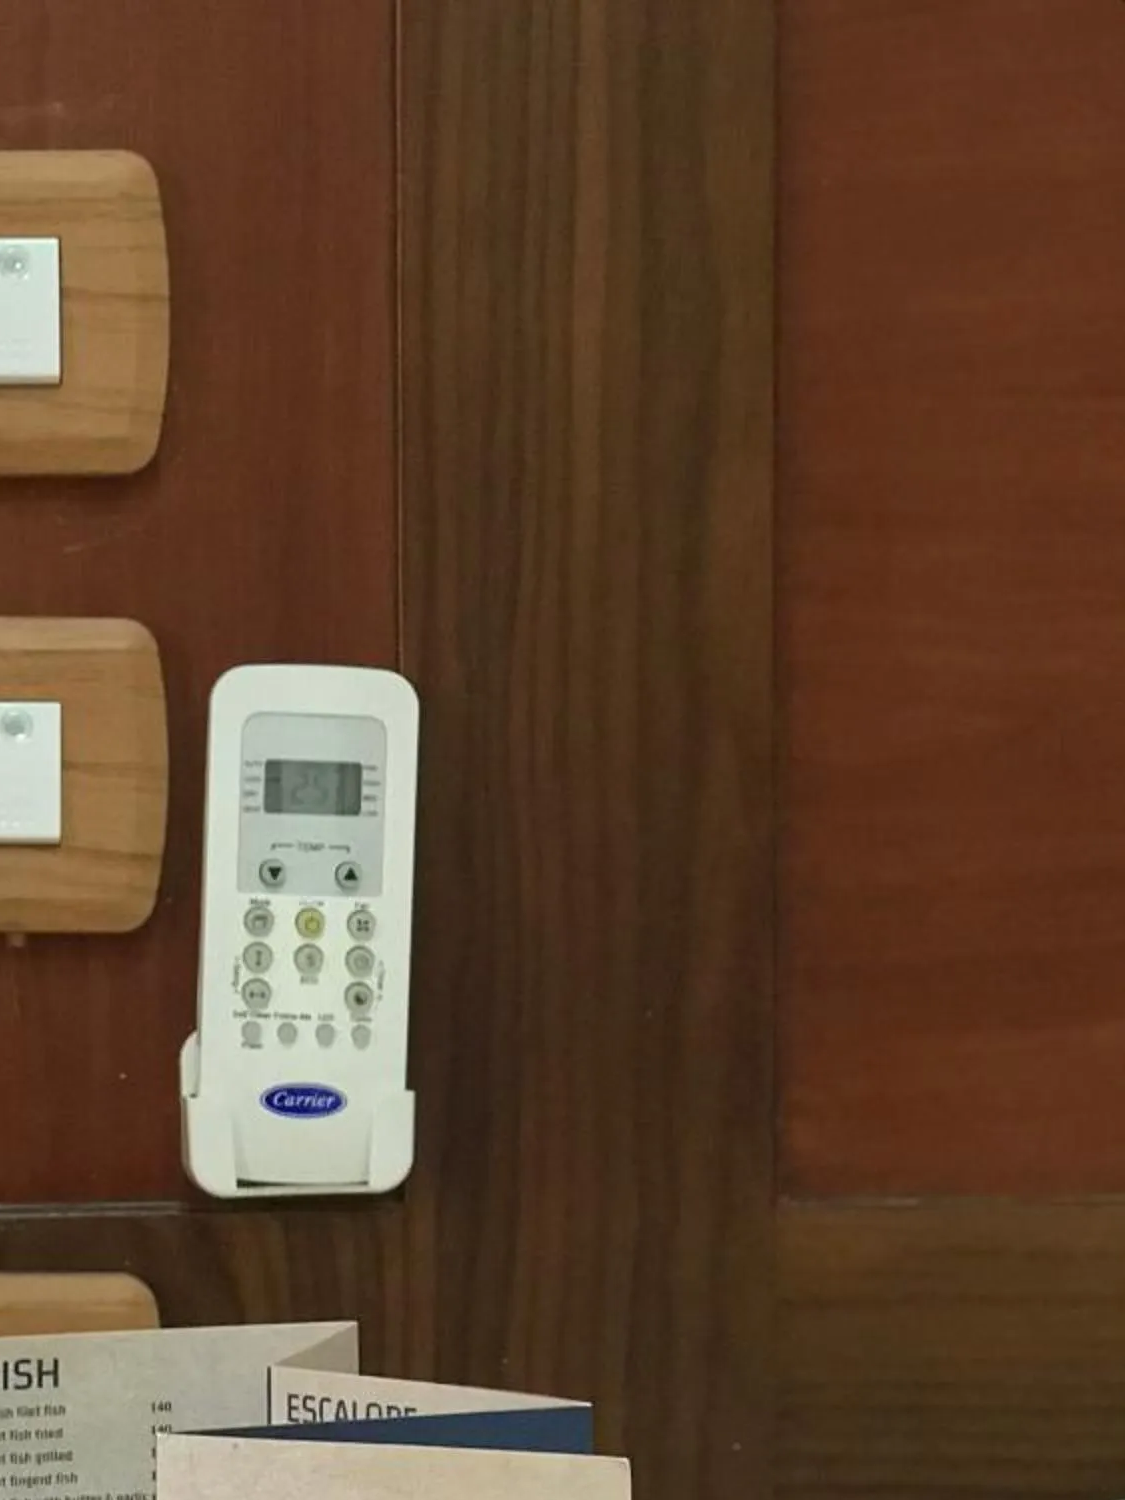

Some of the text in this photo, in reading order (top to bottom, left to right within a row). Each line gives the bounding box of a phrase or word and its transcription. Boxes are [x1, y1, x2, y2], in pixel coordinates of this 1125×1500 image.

[273, 1091, 335, 1108] Carrier
[44, 1404, 66, 1416] fish
[152, 1401, 172, 1413] 140
[10, 1429, 32, 1441] fish
[10, 1452, 32, 1464] fish
[56, 1472, 78, 1484] fish
